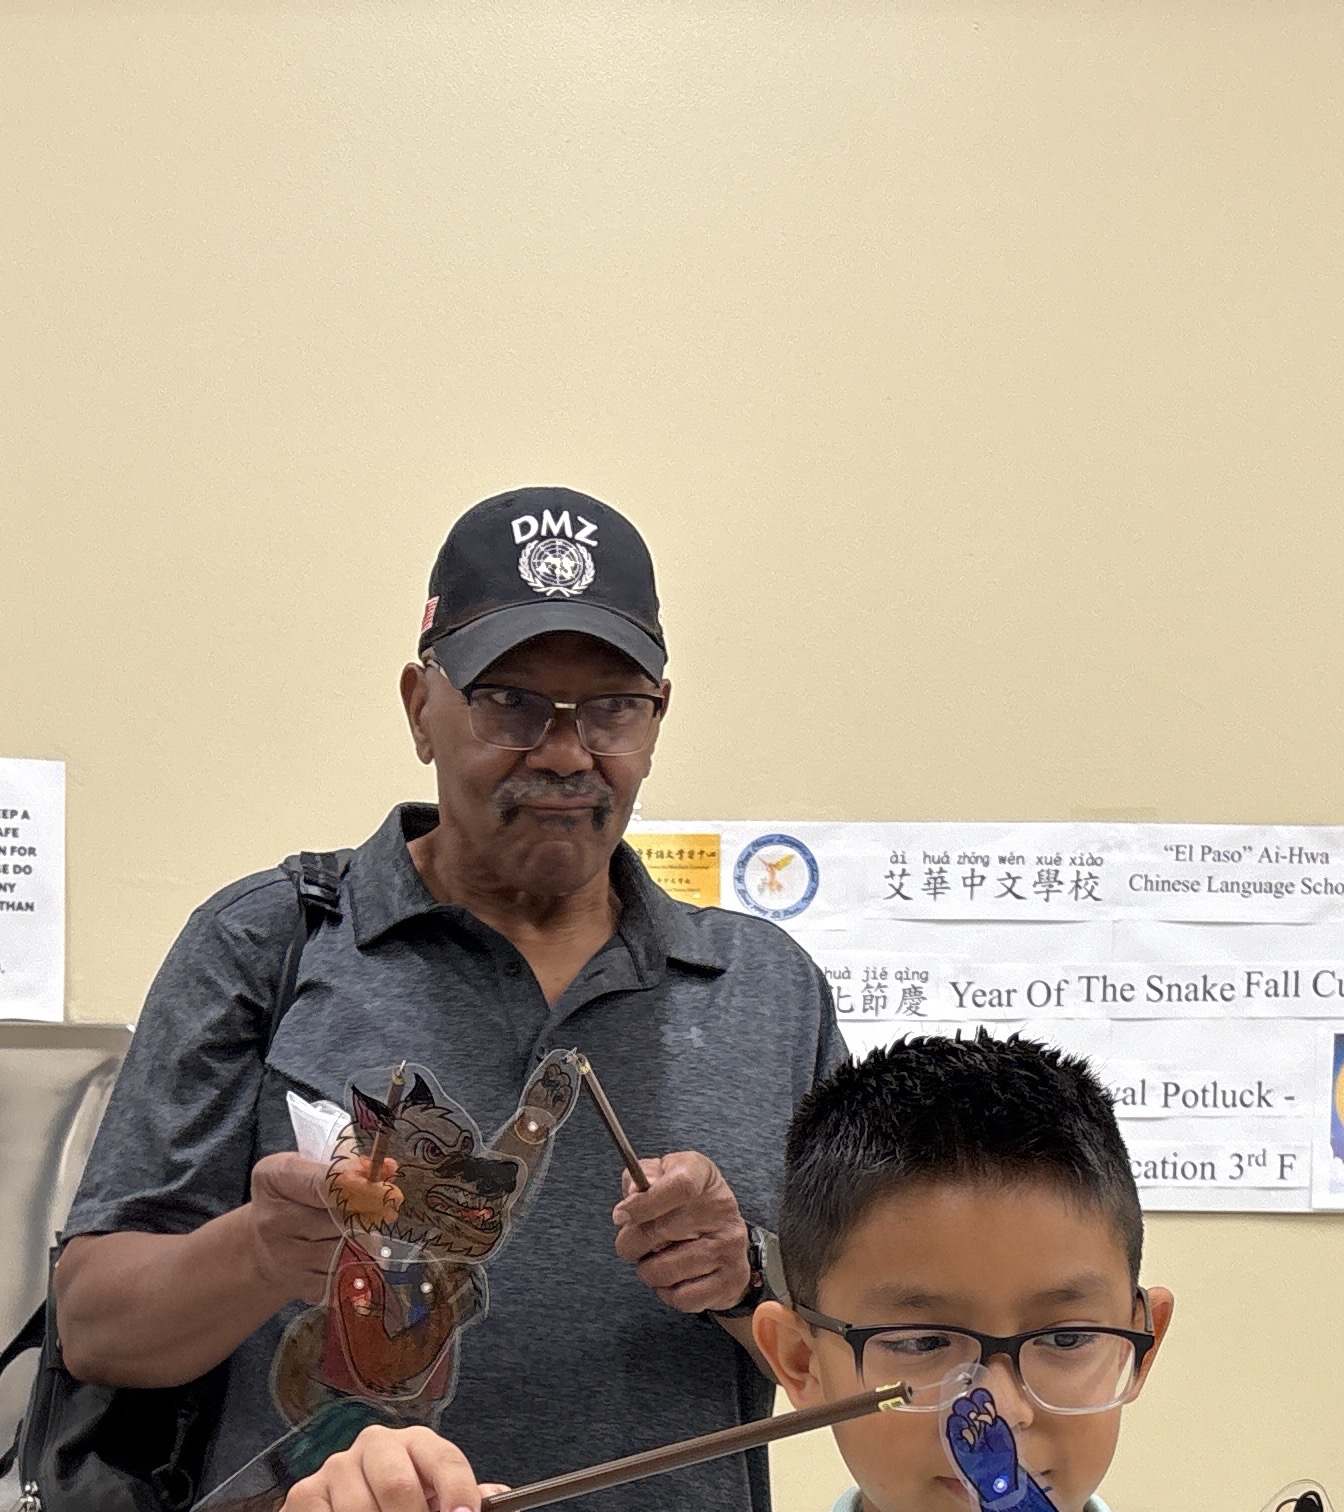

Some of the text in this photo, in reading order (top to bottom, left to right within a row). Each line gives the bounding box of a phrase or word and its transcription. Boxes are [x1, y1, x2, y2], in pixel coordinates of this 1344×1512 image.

[511, 509, 598, 547] DMZ
[21, 810, 30, 820] A
[10, 846, 37, 857] FOR
[1258, 846, 1330, 866] Ai-Hwa
[12, 864, 32, 875] DO
[882, 866, 1104, 903] 艾華中文學校
[1128, 873, 1201, 894] Chinese
[1207, 875, 1295, 899] Language
[948, 980, 1018, 1008] Year
[1026, 979, 1069, 1008] Of
[1077, 974, 1136, 1003] The
[1145, 974, 1236, 1003] Snake
[1243, 969, 1301, 998] Fall
[1161, 1080, 1274, 1109] Potluck
[1129, 1152, 1216, 1180] cation
[1277, 1153, 1297, 1180] F
